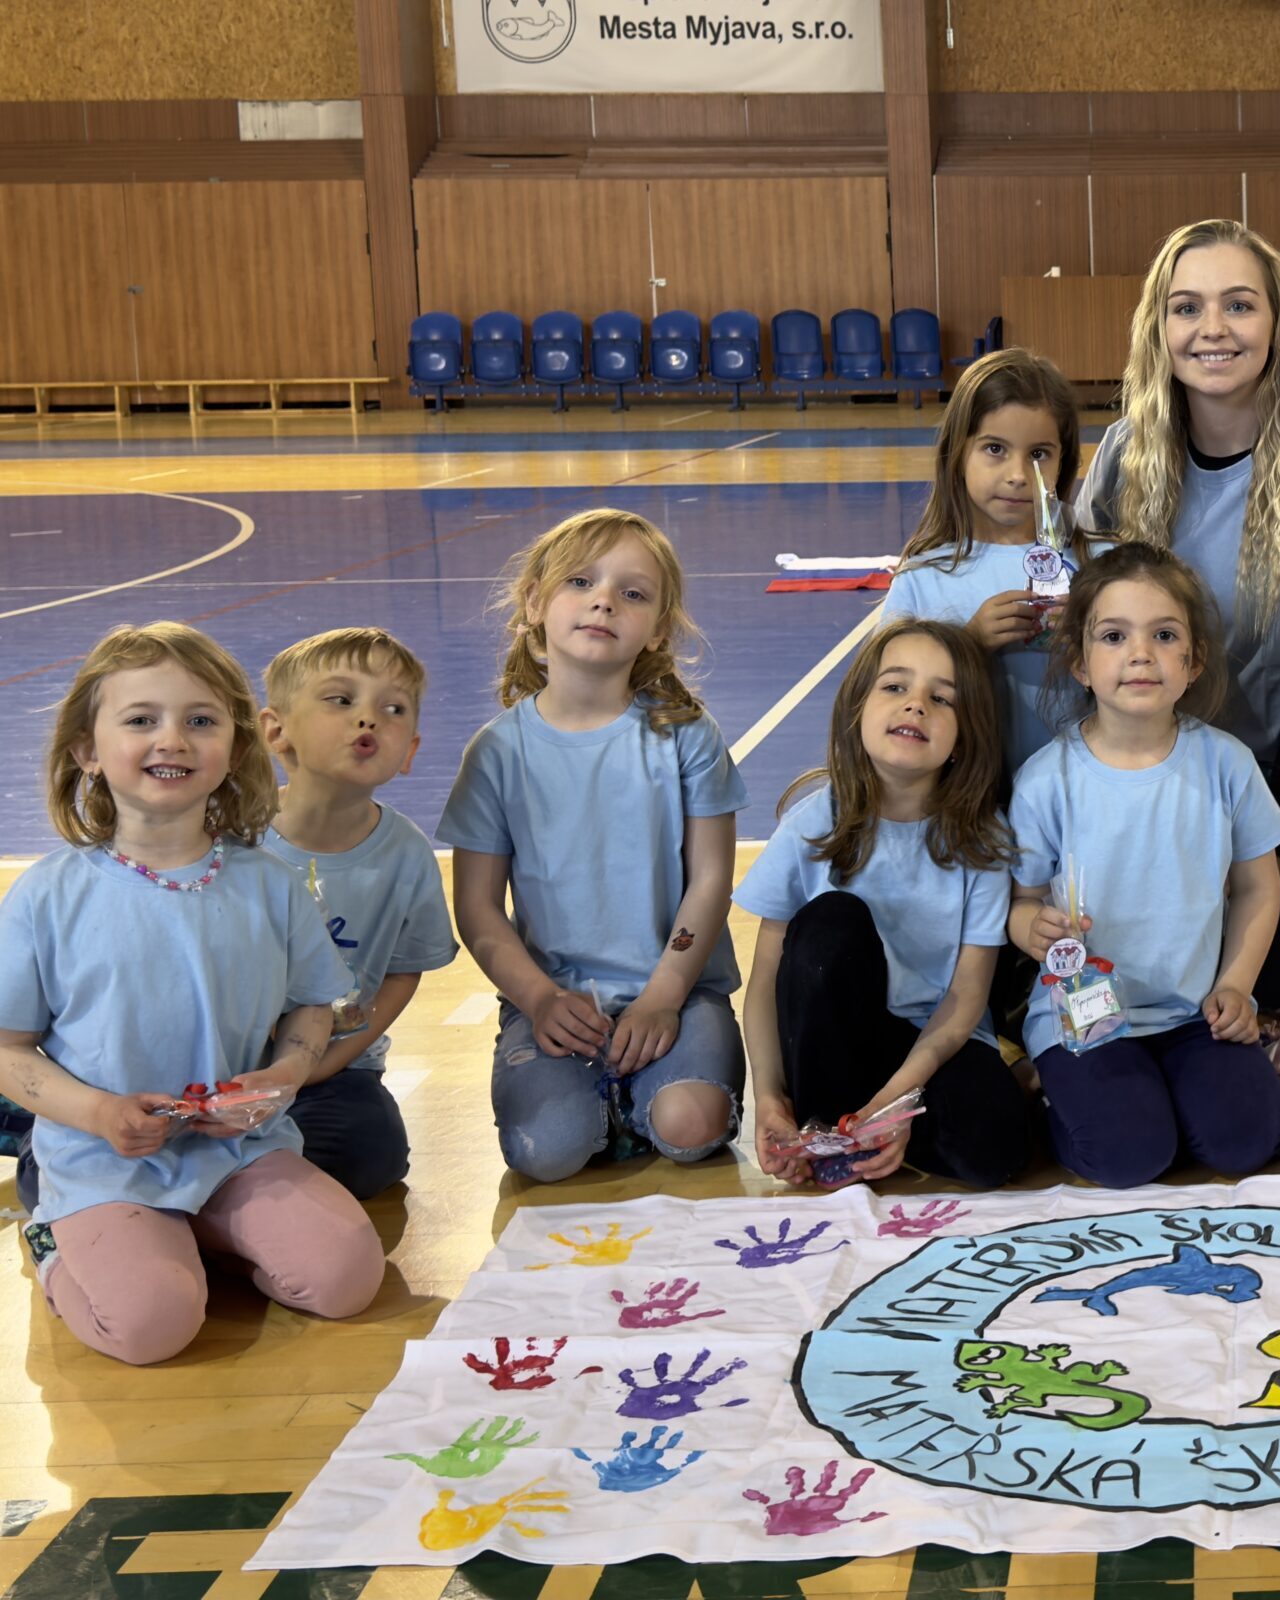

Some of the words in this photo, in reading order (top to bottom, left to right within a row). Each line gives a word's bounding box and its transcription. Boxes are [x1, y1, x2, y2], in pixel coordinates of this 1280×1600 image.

[599, 15, 676, 39] Mesta
[685, 15, 783, 45] Myjava,
[791, 21, 853, 39] s.r.o.
[832, 1370, 1147, 1498] MATEŘSKÁ
